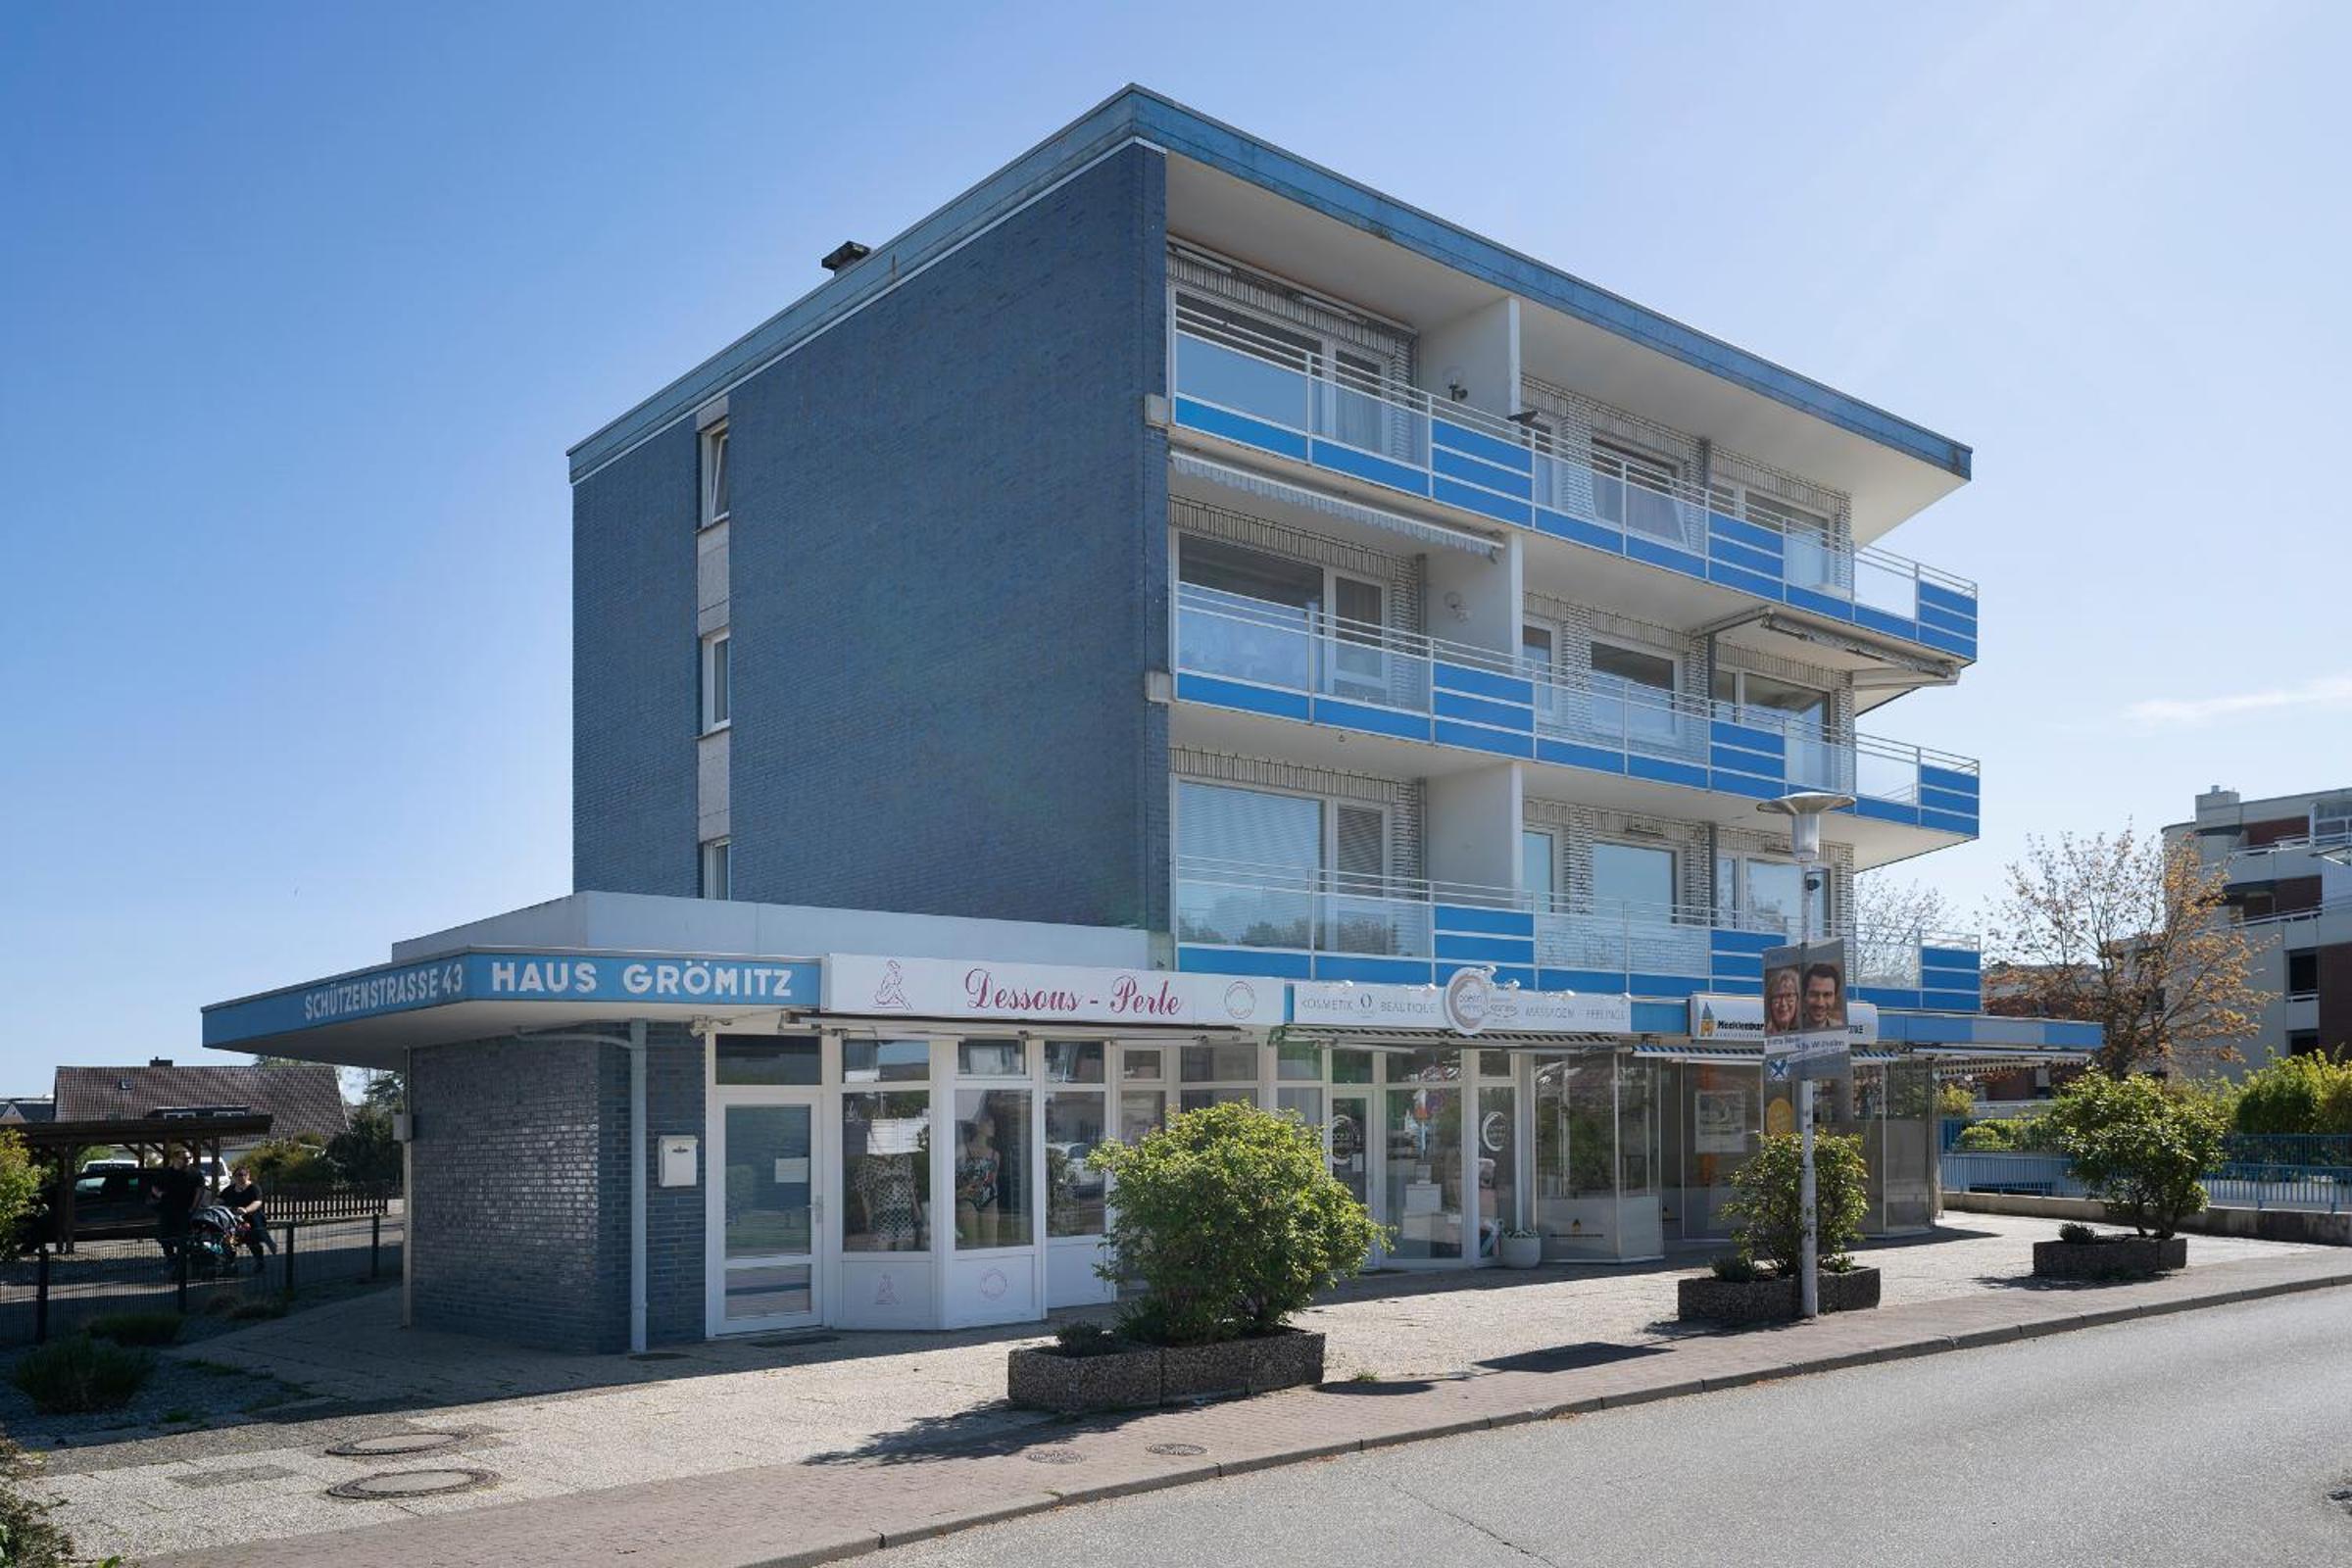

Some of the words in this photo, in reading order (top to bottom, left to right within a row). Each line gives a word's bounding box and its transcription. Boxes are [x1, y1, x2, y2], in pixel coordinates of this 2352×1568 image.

[304, 969, 438, 1019] SCHÜTZENSTRASSE
[441, 963, 465, 995] 43
[492, 961, 597, 994] HAUS
[623, 959, 793, 998] GRÖMITZ
[965, 967, 1081, 1013] Dessous
[1109, 974, 1182, 1015] Perle
[1301, 998, 1354, 1011] KOSMETIK
[1525, 1004, 1576, 1019] MASSAGEN
[1717, 1019, 1764, 1031] Mecklenbur
